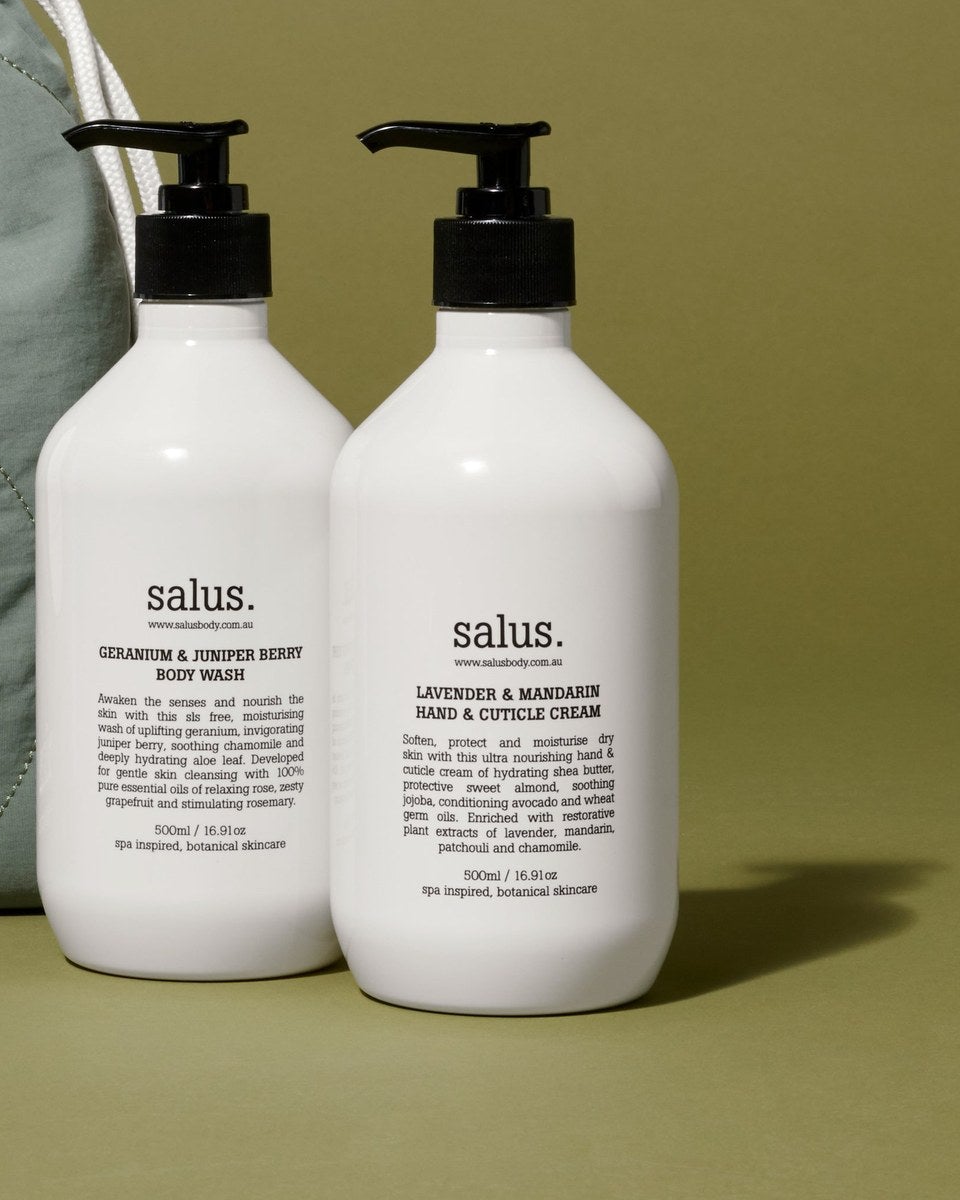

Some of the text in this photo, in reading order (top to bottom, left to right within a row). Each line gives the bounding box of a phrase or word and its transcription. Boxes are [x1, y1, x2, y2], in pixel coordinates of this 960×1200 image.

[147, 578, 254, 612] salus.
[148, 620, 253, 632] www.salusbody.com.au
[453, 613, 563, 649] salus.
[99, 645, 303, 662] GERANIUM & JUNIPER BERRY
[454, 657, 563, 669] www.salusbody.com.au
[155, 668, 245, 682] BODY WASH
[97, 693, 304, 708] Awaken the senses and nourish the
[416, 684, 600, 701] LAVENDER & MANDARIN
[97, 707, 304, 723] skin with this sls free, moisturising
[415, 704, 601, 721] HAND & CUTICLE CREAM
[97, 736, 304, 754] juniper berry, soothing chamomile and
[402, 733, 615, 750] Soften, protect and moisturise dry
[97, 750, 304, 768] deeply hydrating aloe leaf. Developed
[402, 764, 614, 781] cuticle cream of hydrating shea butter,
[105, 796, 296, 811] grapefruit and stimulating rosemary.
[402, 793, 615, 811] jojoba, conditioning avocado and wheat
[403, 808, 615, 824] germ oils. Enriched with restorative
[154, 824, 191, 836] 500ml
[204, 825, 246, 836] 16.91oz
[115, 839, 286, 853] spa inspired, botanical skincare
[438, 840, 581, 854] patchouli and chamomile.
[464, 869, 501, 881] 500ml
[515, 869, 558, 881] 16.91oz
[422, 884, 598, 899] spa inspired, botanical skincare
